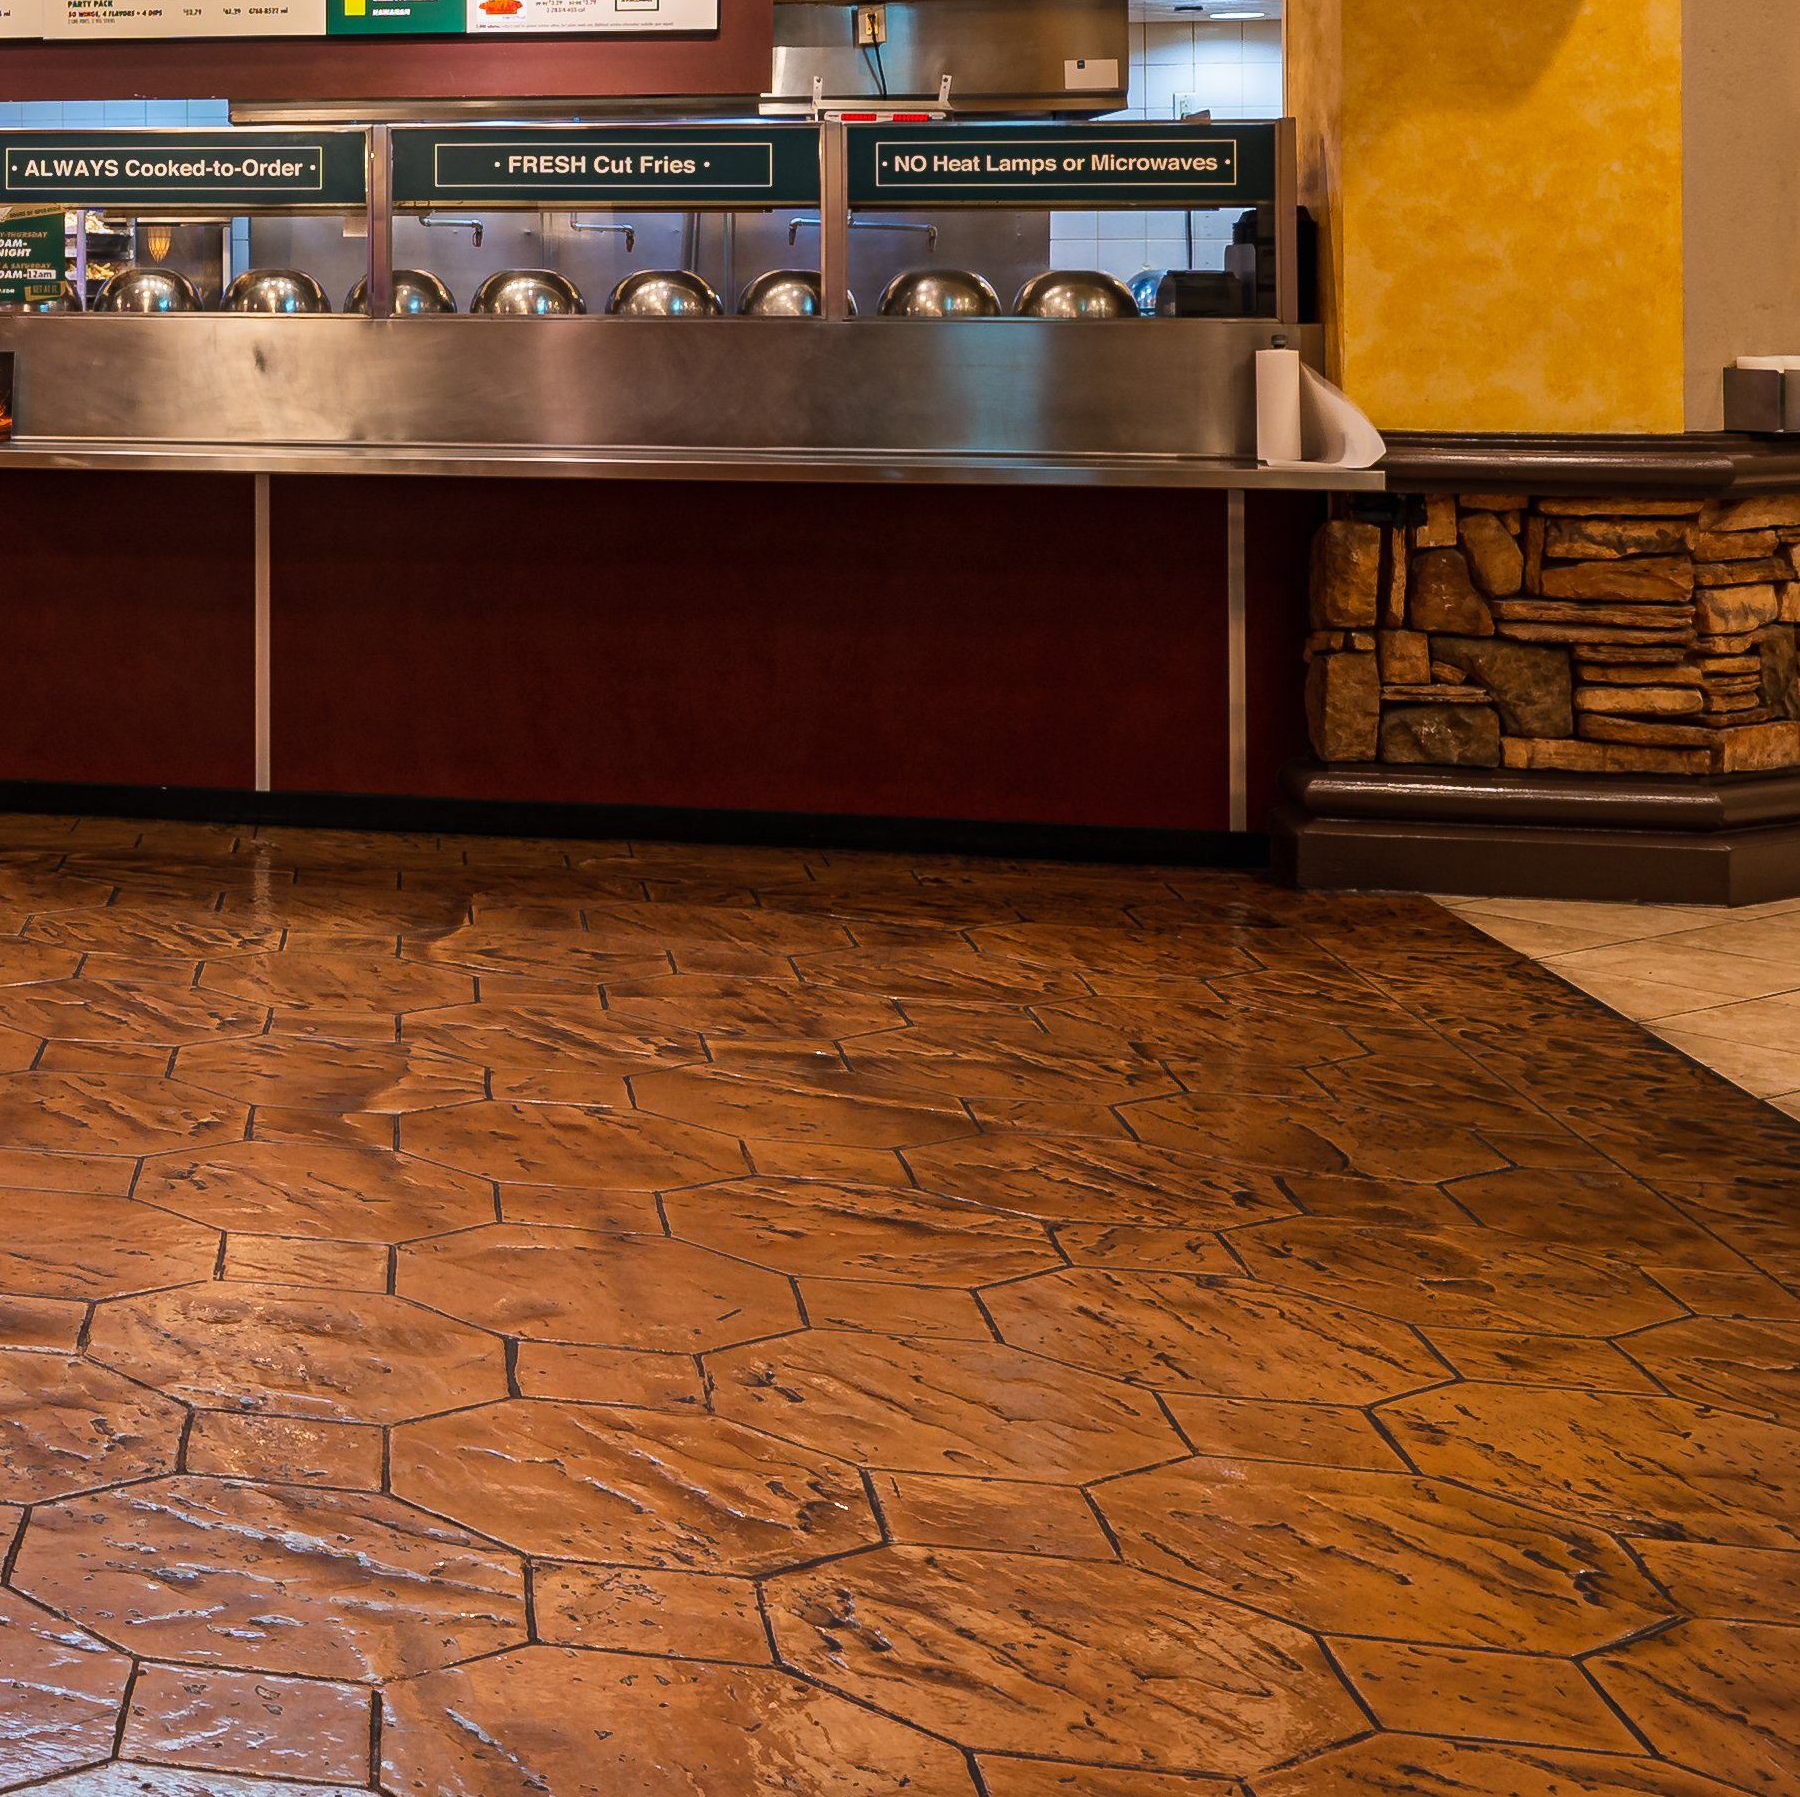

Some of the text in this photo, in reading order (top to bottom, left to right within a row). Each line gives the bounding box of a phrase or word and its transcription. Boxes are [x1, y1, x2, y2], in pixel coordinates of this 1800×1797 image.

[67, 0, 113, 8] PARTY PACK
[24, 158, 304, 177] ALWAYS Cooked-to-Order
[508, 155, 696, 174] FRESH Cut Fries
[894, 153, 1218, 176] NO Heat Lamps or Microwaves
